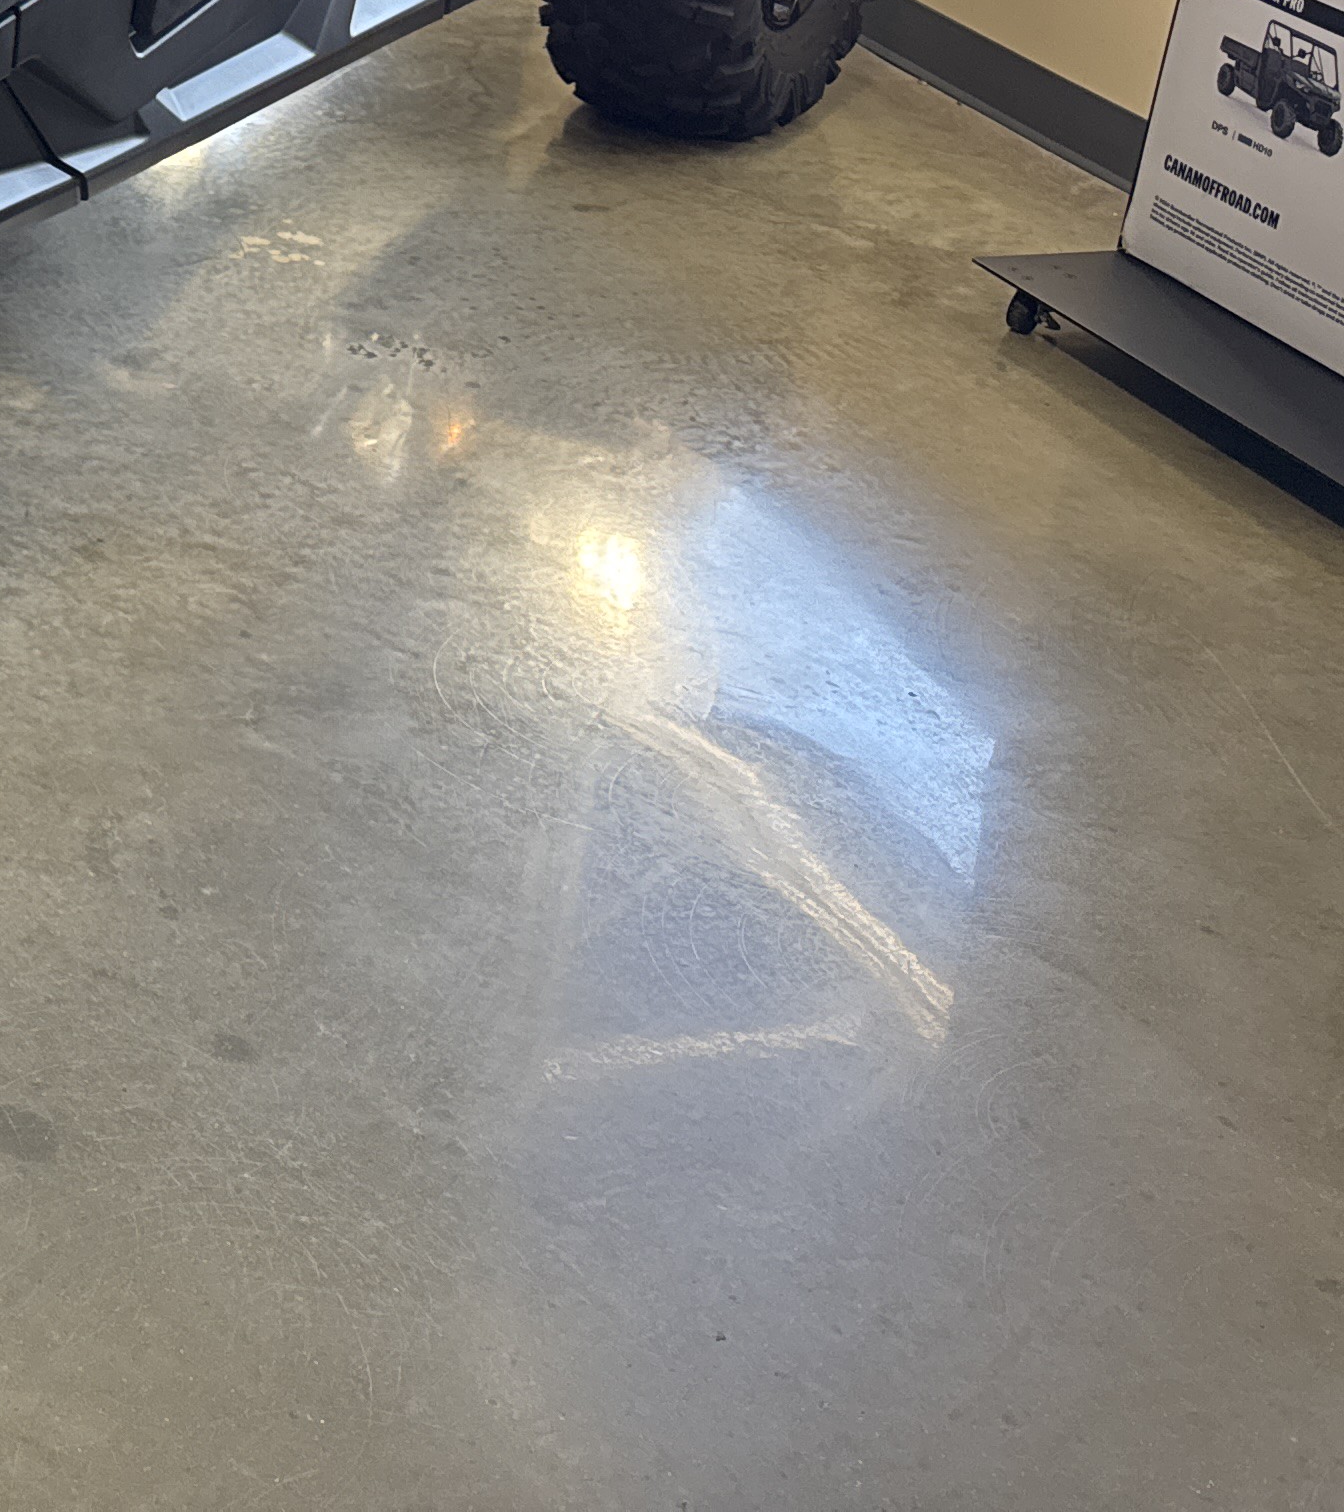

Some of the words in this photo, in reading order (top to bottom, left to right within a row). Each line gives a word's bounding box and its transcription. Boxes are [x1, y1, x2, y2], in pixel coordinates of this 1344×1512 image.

[1212, 120, 1229, 136] DPS
[1252, 141, 1273, 158] HD10
[1163, 153, 1281, 230] CANAMOFFROAD.COM
